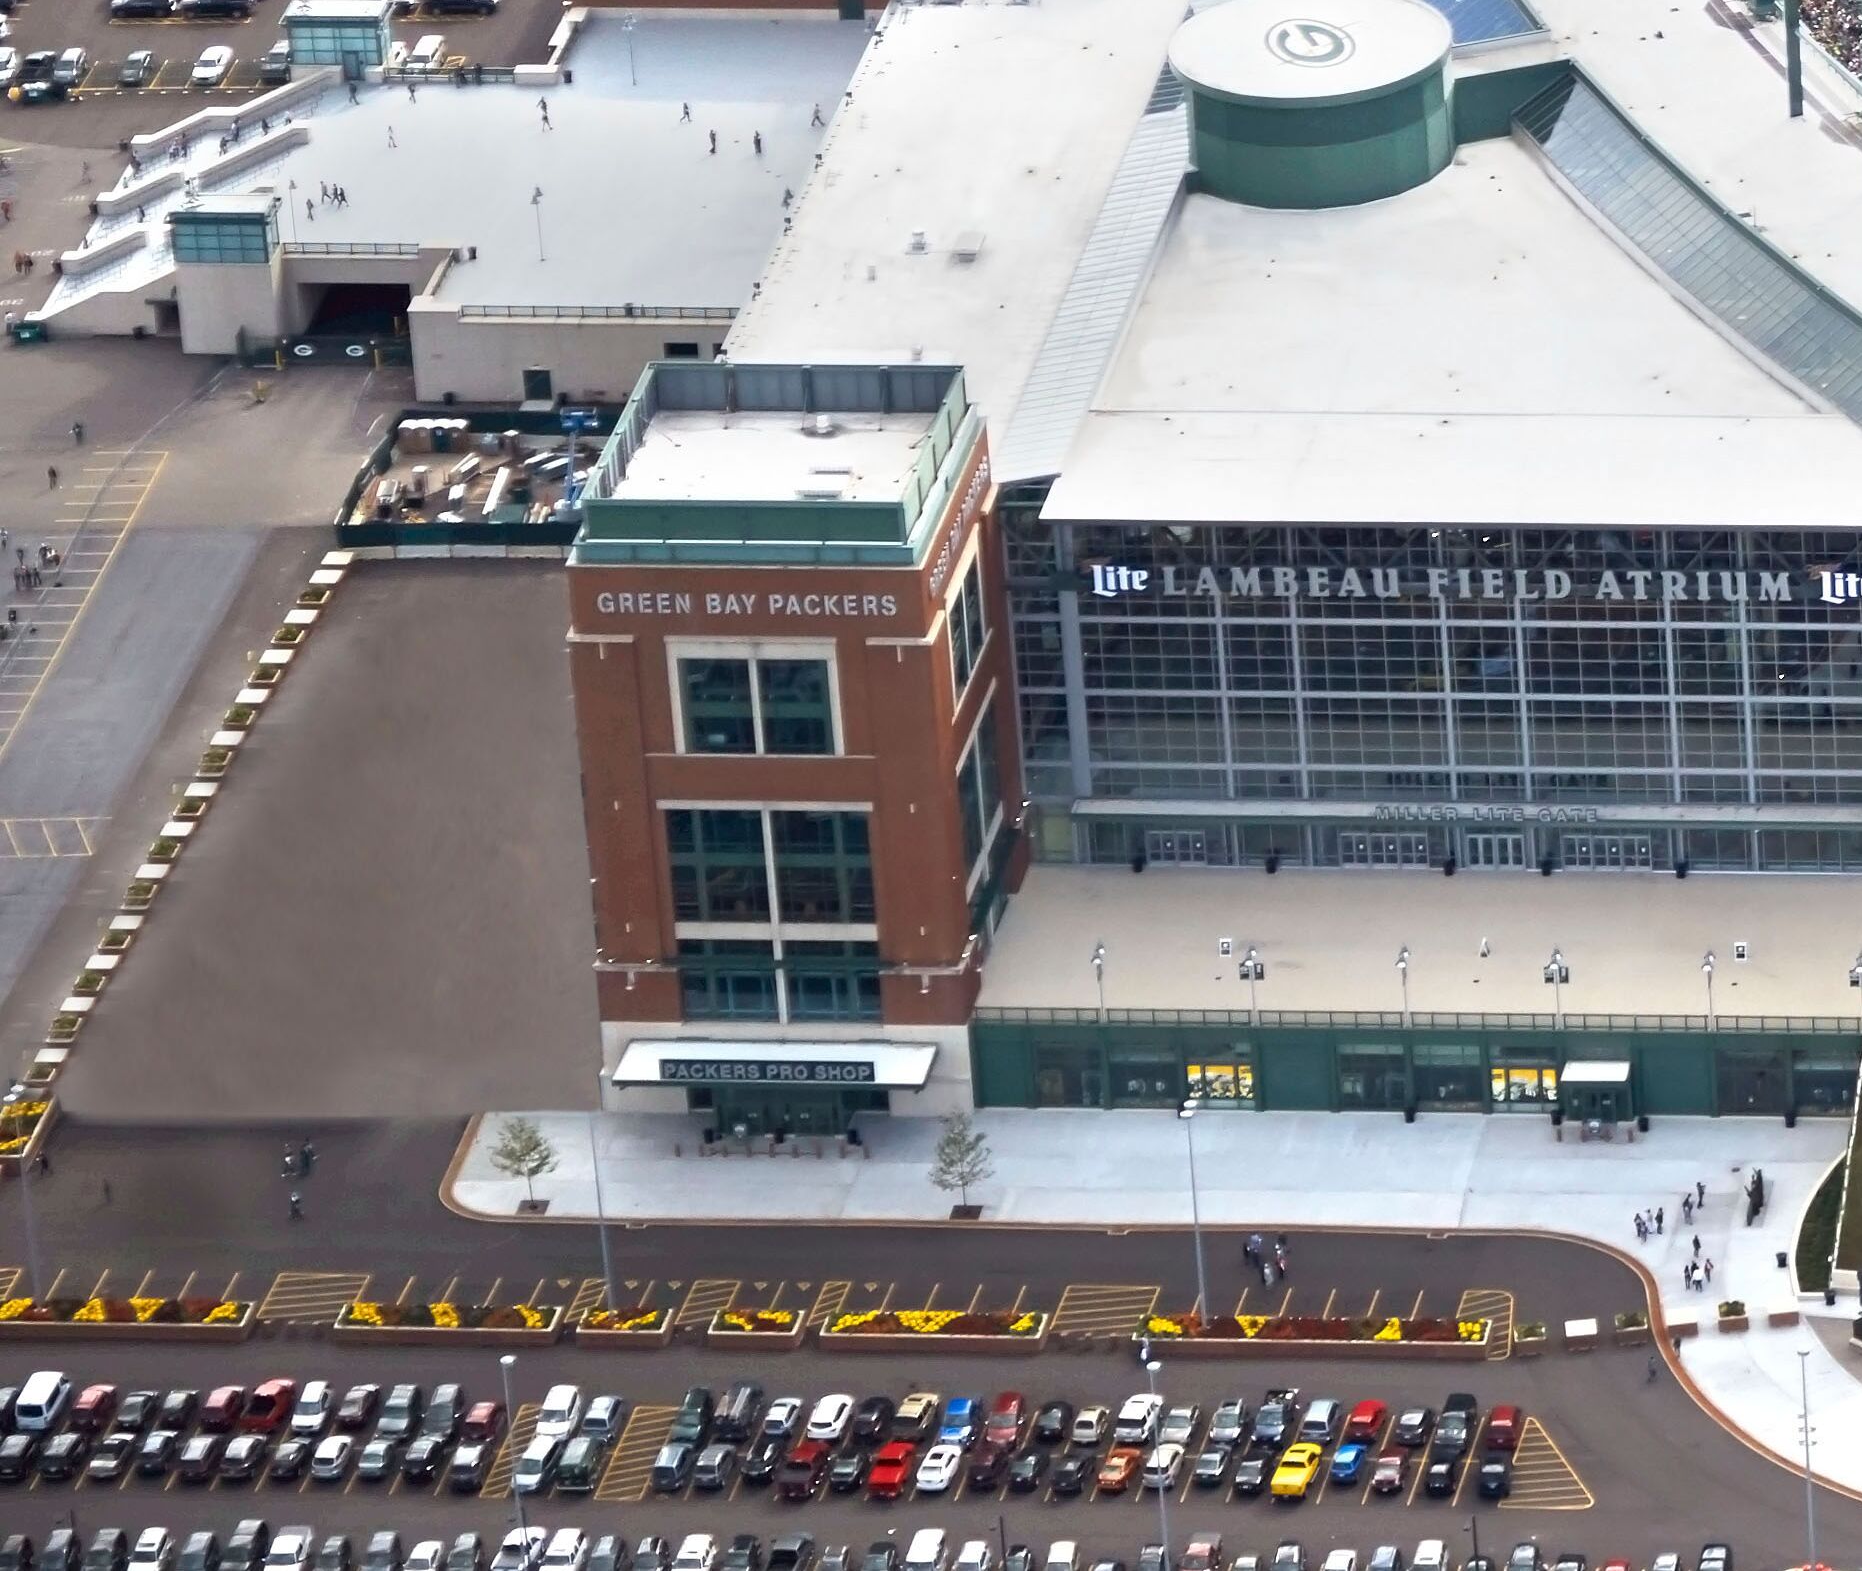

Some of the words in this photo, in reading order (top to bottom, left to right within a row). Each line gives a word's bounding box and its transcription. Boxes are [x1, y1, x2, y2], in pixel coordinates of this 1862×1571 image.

[1090, 563, 1149, 597] Lite
[1162, 566, 1400, 598] LAMBEAU
[1427, 568, 1572, 600] FIELD
[1595, 570, 1793, 602] ATRIUM
[597, 591, 691, 614] GREEN
[706, 592, 758, 615] BAY
[769, 594, 898, 617] PACKERS
[1375, 806, 1458, 822] MILLER
[1473, 807, 1524, 822] LITE
[1538, 808, 1597, 823] GATE
[663, 1063, 760, 1080] PACKERS
[766, 1064, 808, 1080] PRO
[815, 1065, 871, 1081] SHOP
